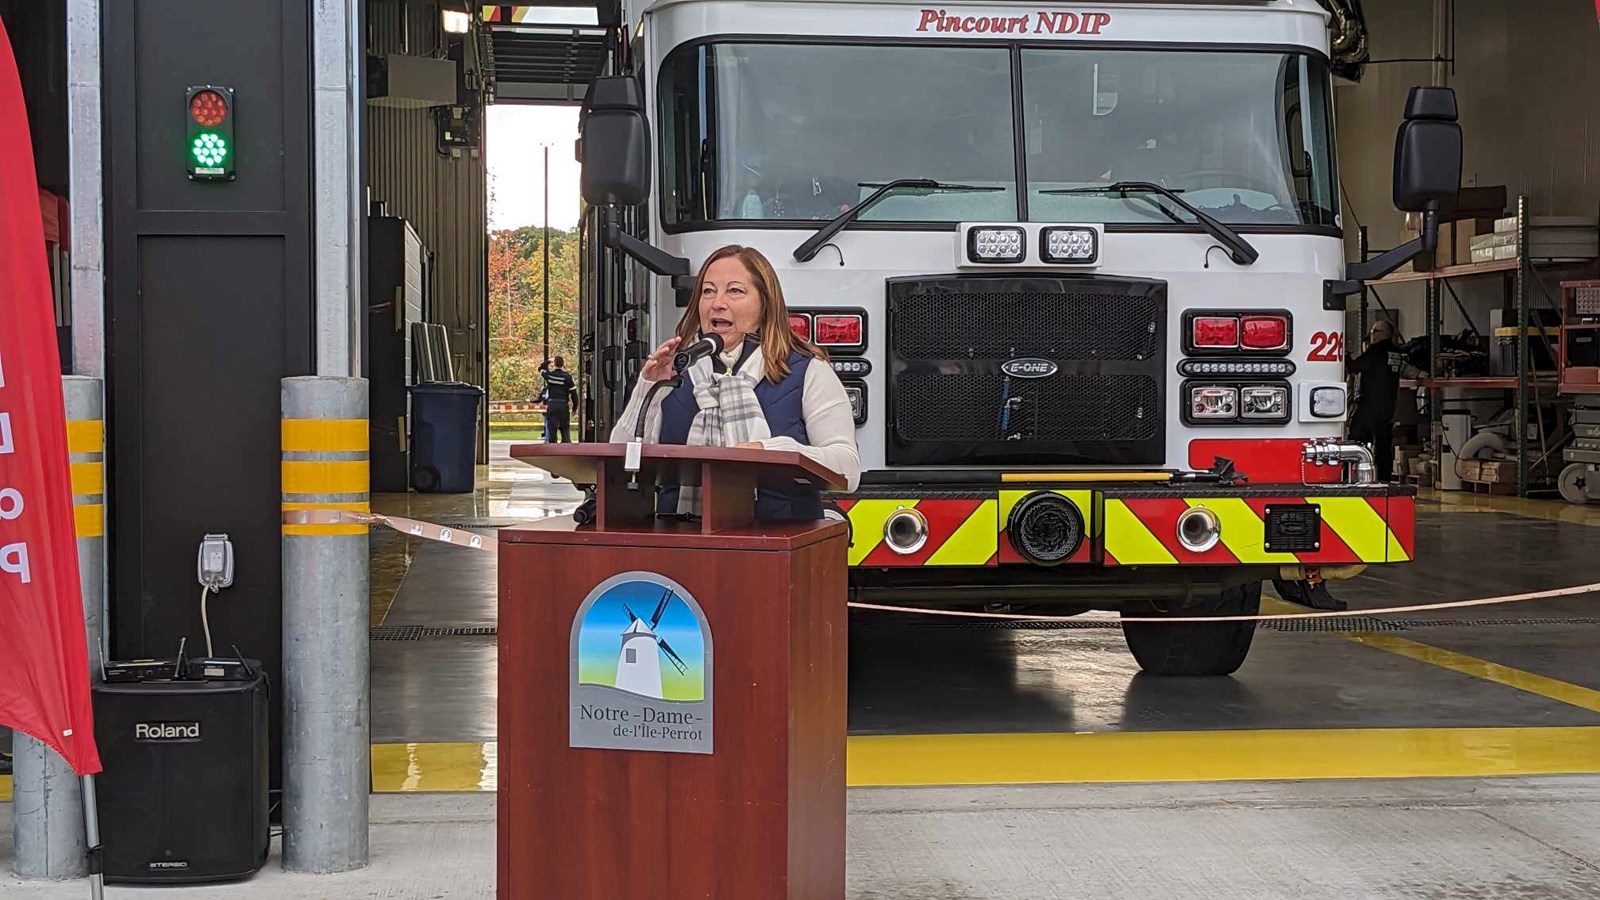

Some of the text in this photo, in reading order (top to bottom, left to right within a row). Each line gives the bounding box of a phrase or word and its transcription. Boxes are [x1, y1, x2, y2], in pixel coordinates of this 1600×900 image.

[916, 10, 1110, 35] Pincourt NDIP
[1010, 363, 1049, 373] E-ONE
[135, 722, 200, 739] Roland
